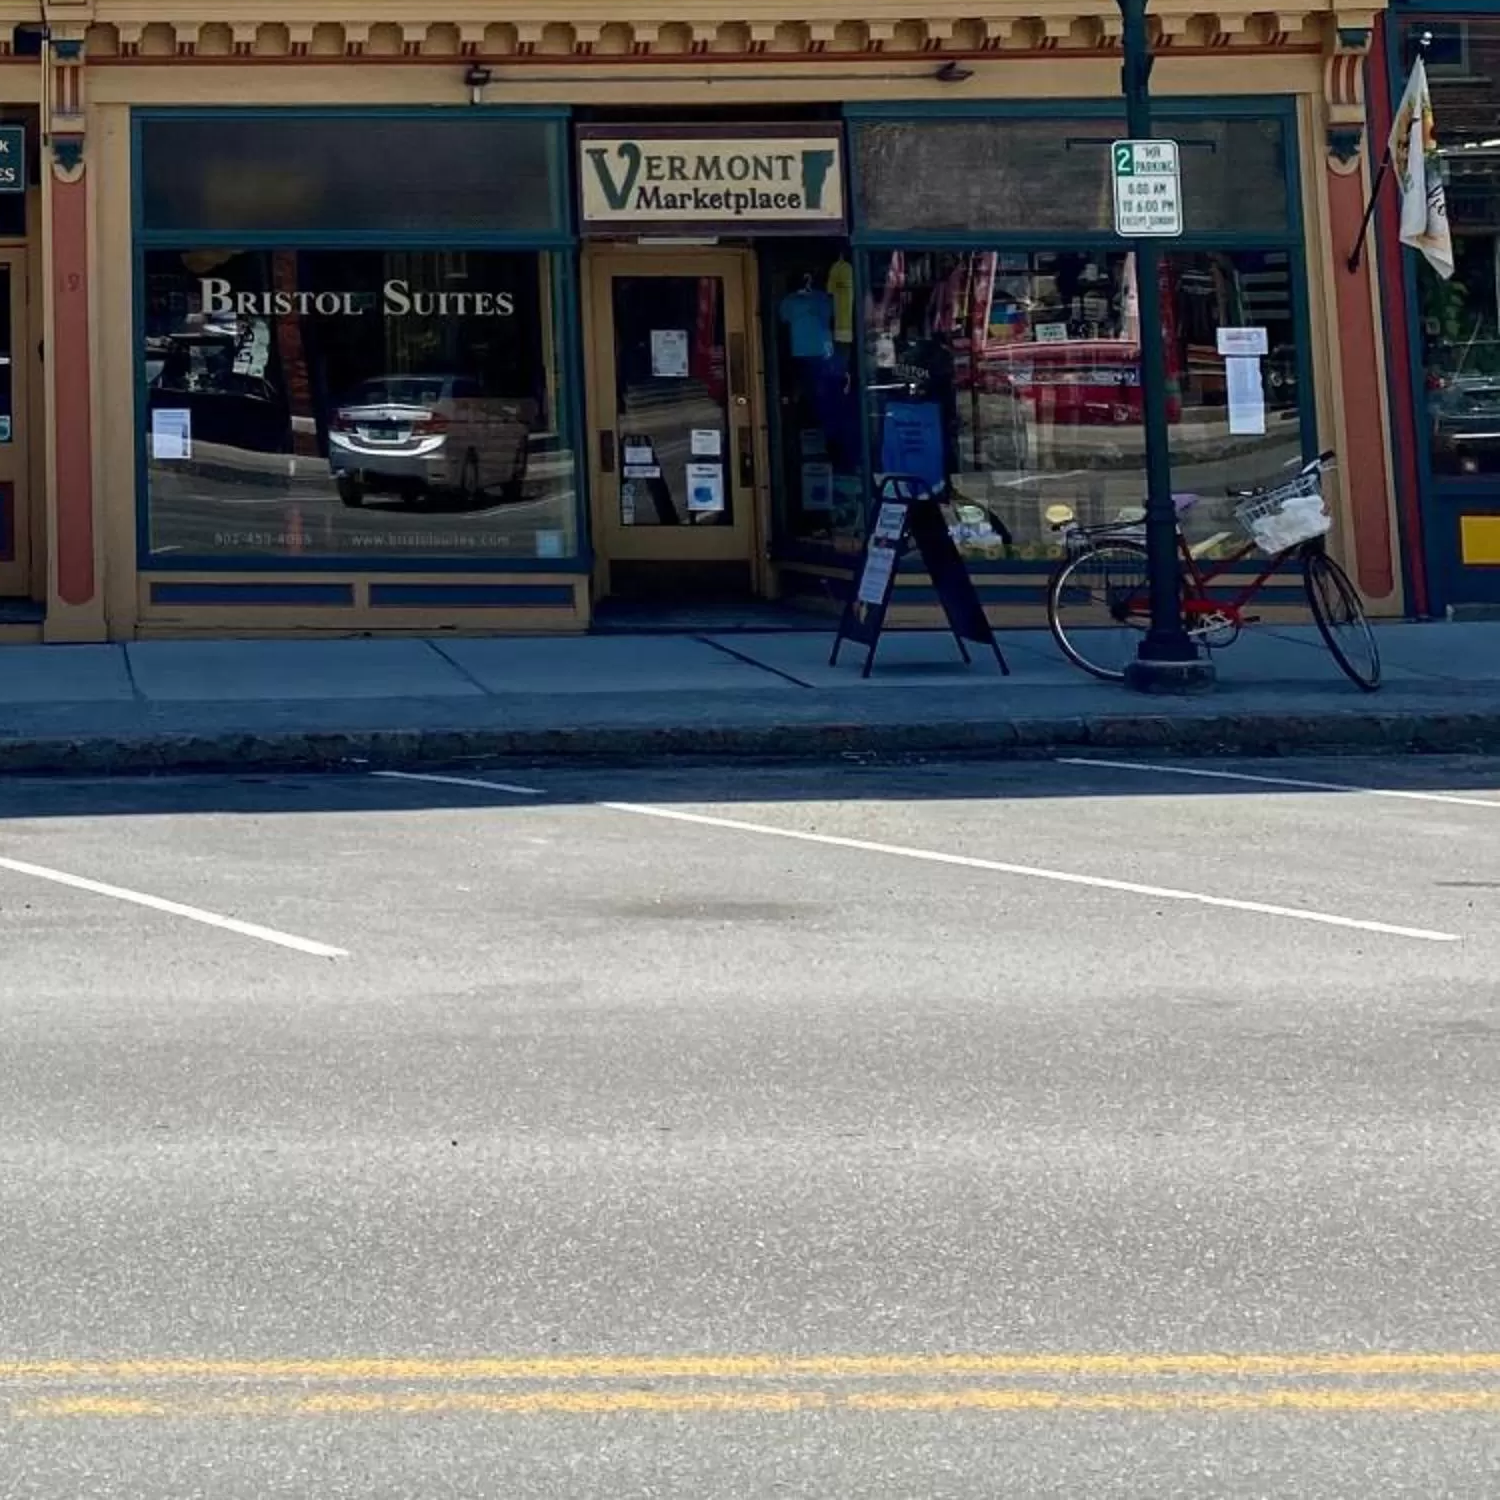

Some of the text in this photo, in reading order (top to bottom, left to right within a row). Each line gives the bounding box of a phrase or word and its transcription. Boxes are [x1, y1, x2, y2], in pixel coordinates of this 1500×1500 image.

[1117, 147, 1132, 172] 2
[1136, 160, 1174, 172] PARKING
[585, 142, 795, 210] VERMONT
[1153, 183, 1167, 194] AM
[635, 186, 801, 215] Marketplace
[1162, 200, 1174, 212] PM
[199, 278, 514, 315] BRISTOL SUITES
